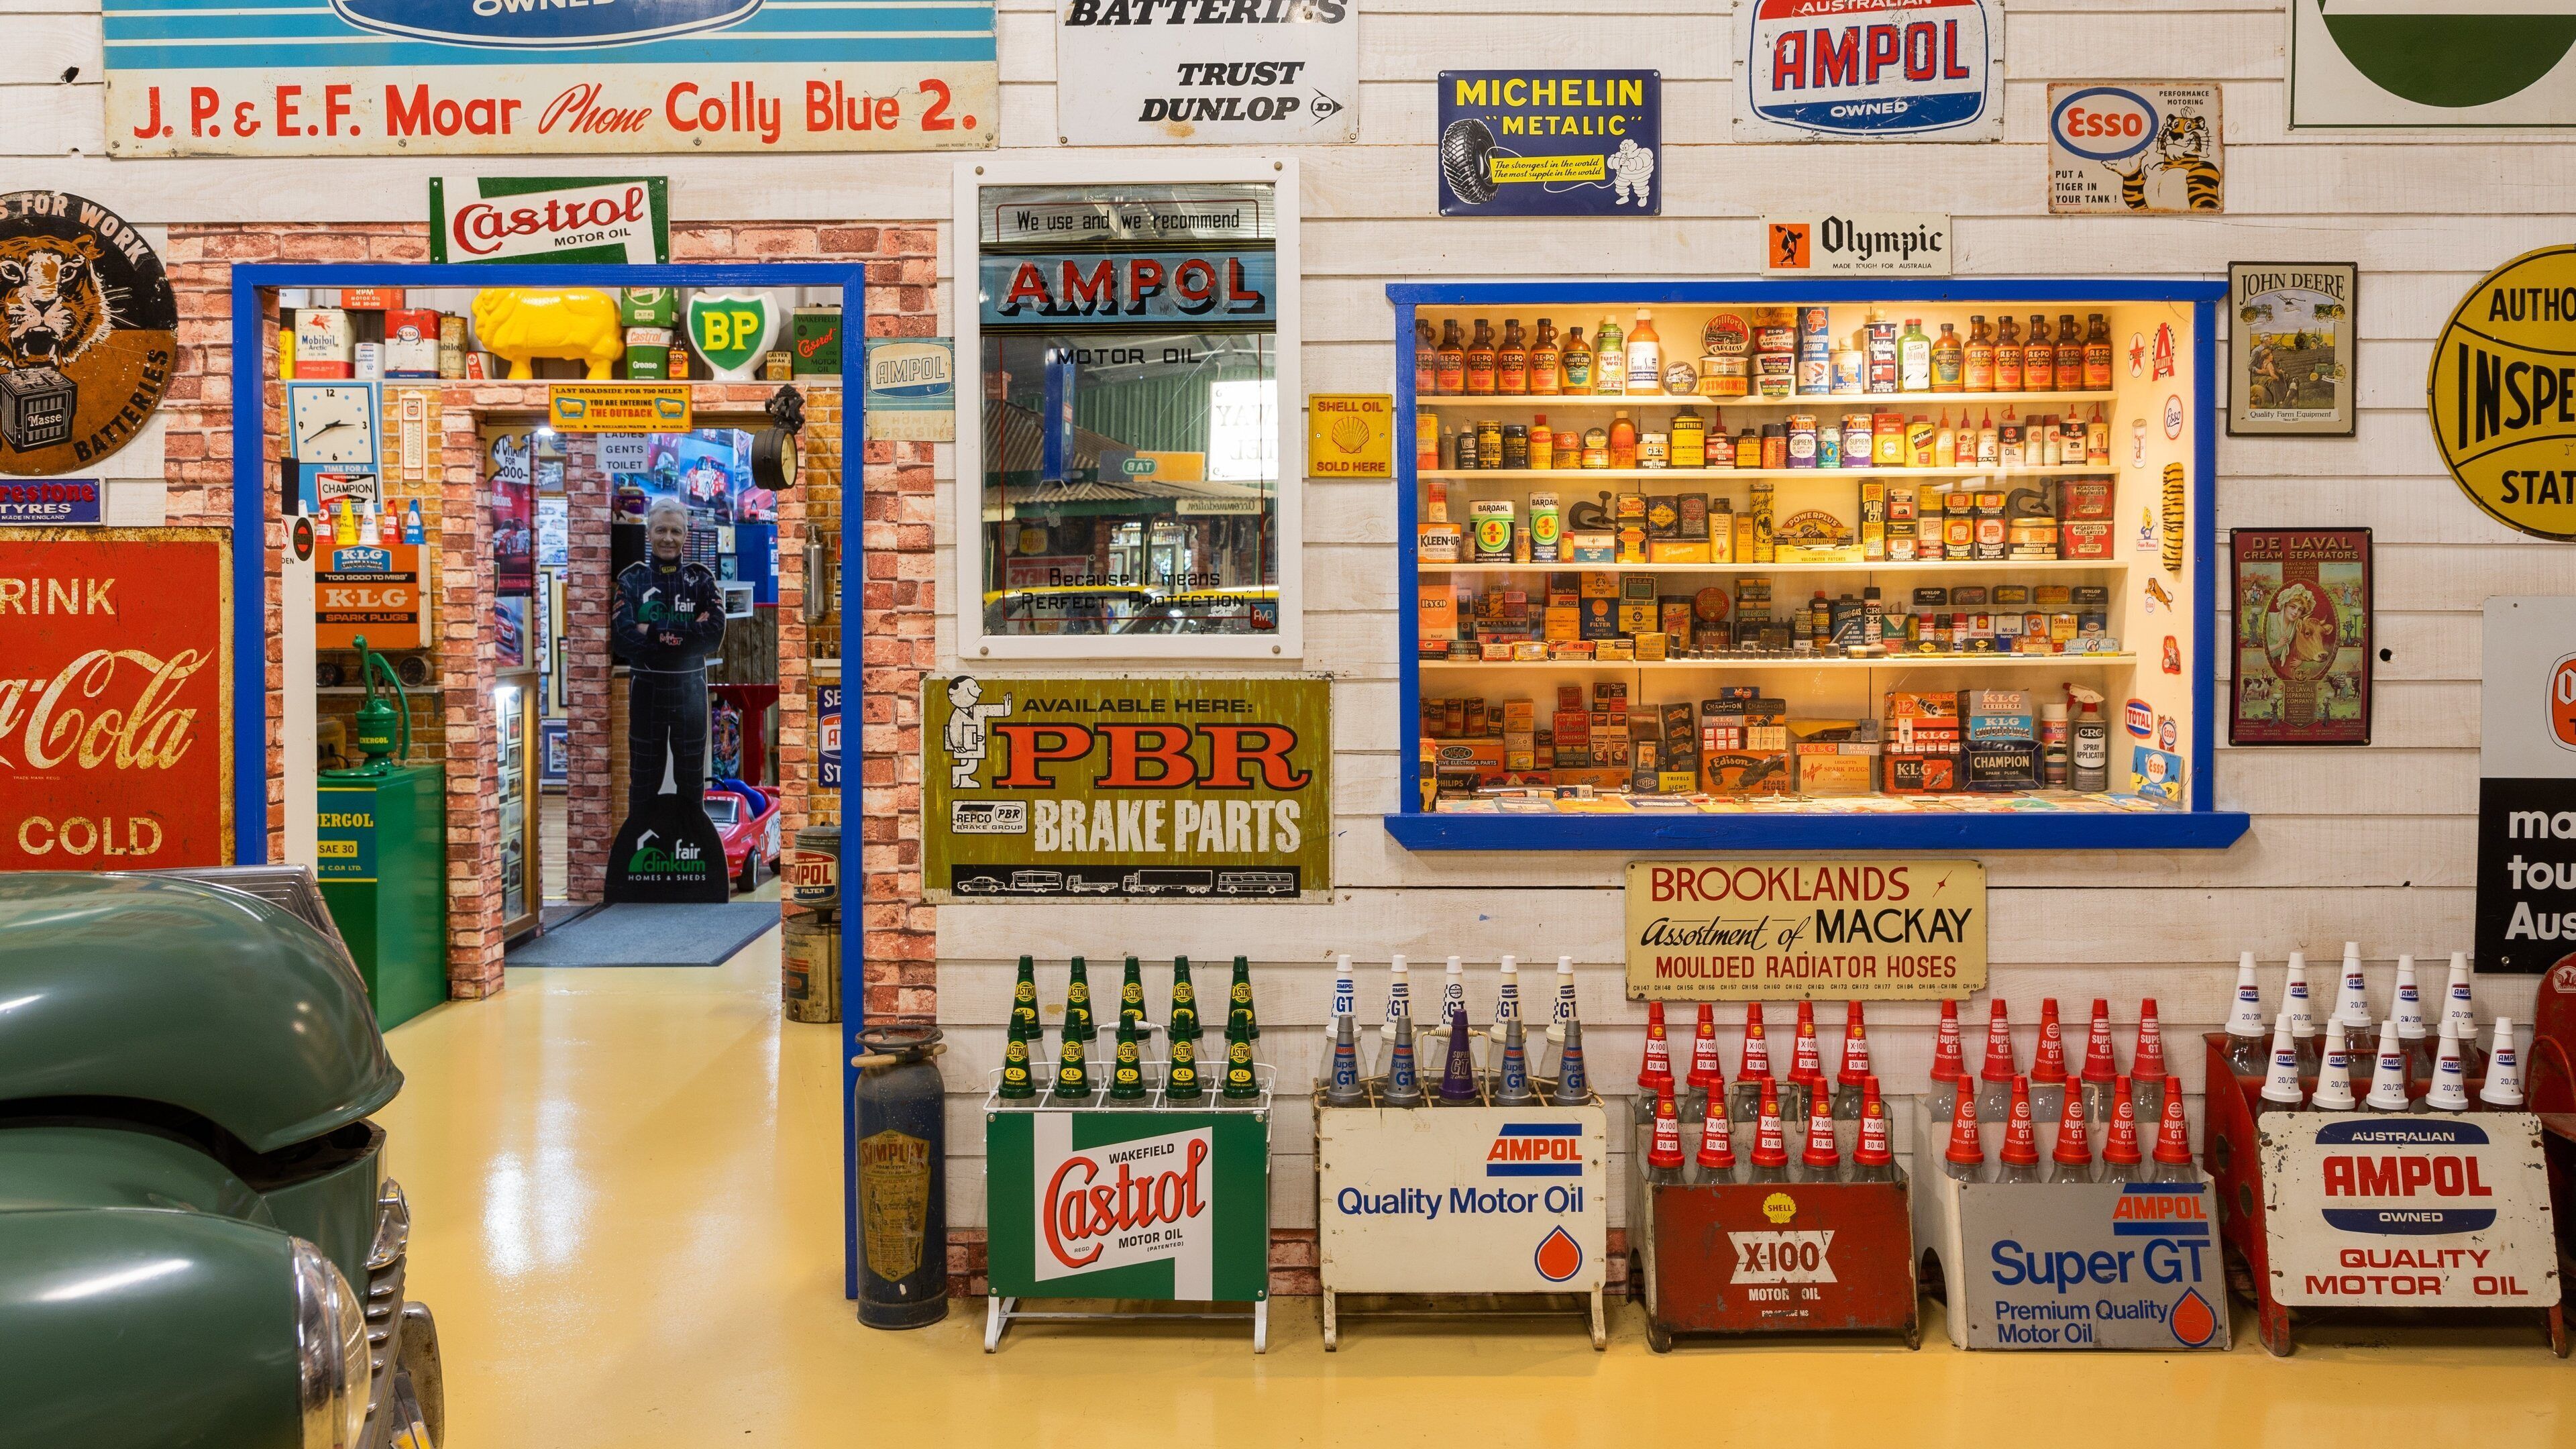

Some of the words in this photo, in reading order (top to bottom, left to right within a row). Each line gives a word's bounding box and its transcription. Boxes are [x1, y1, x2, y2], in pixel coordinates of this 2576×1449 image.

[1772, 19, 1970, 92] AMPOL
[1177, 61, 1305, 86] TRUST
[1456, 77, 1643, 107] MICHELIN
[384, 84, 522, 137] Moar
[538, 83, 653, 134] Phone
[665, 81, 780, 144] Colly
[806, 80, 900, 131] Blue
[919, 78, 977, 131] 2.
[1138, 97, 1299, 123] DUNLOP
[1830, 101, 1909, 117] OWNED
[1494, 170, 1508, 178] The
[1528, 169, 1554, 180] supple
[1578, 167, 1602, 176] world
[1496, 160, 1510, 169] The
[1511, 160, 1548, 172] strongest
[1561, 160, 1574, 168] the
[1574, 158, 1599, 166] world
[2055, 170, 2074, 178] PUT
[2077, 170, 2084, 178] A
[2055, 182, 2083, 191] TIGER
[2087, 182, 2097, 191] IN
[2055, 195, 2081, 203] YOUR
[2085, 195, 2110, 203] TANK
[453, 186, 645, 255] Castrol
[1016, 211, 1040, 231] We
[1047, 215, 1074, 230] use
[1082, 210, 1110, 230] and
[1120, 213, 1142, 229] we
[1152, 208, 1240, 230] recommend
[21, 193, 69, 218] FOR
[78, 201, 150, 268] WORK
[554, 231, 604, 248] MOTOR
[609, 227, 632, 239] OIL
[1821, 215, 1943, 262] Olympic
[998, 257, 1266, 316] AMPOL
[2239, 272, 2287, 306] JOHN
[2290, 272, 2346, 302] DEERE
[797, 315, 838, 323] WAKEFIELD
[630, 331, 664, 343] Castrol
[701, 311, 759, 351] BP
[1057, 348, 1146, 365] MOTOR
[1163, 347, 1201, 364] OIL
[632, 361, 657, 370] Grease
[876, 356, 945, 384] AMPOL
[73, 348, 170, 464] BATTERIES
[590, 409, 608, 417] THE
[609, 409, 653, 418] OUTBACK
[1318, 401, 1359, 412] SHELL
[1361, 401, 1384, 412] OIL
[28, 412, 62, 428] Masse
[2250, 411, 2275, 419] Quality
[2296, 411, 2332, 419] Equipment
[606, 445, 644, 453] GENTS
[606, 461, 643, 470] TOILET
[1316, 462, 1350, 472] SOLD
[1352, 462, 1386, 472] HERE
[322, 484, 373, 494] CHAMPION
[1477, 504, 1509, 514] BARDAHL
[2252, 537, 2282, 551] DE
[2290, 537, 2355, 551] LAVAL
[2243, 551, 2284, 559] CREAM
[2289, 551, 2359, 559] SEPARATORS
[1049, 568, 1130, 587] Because
[1161, 572, 1221, 586] means
[325, 614, 367, 622] SPARK
[370, 613, 409, 621] PLUGS
[1022, 698, 1165, 713] AVAILABLE
[1174, 698, 1253, 713] HERE:
[2127, 709, 2151, 729] TOTAL
[2080, 729, 2104, 738] CRC
[1442, 747, 1473, 759] DISCO
[2076, 751, 2105, 759] APPLICATOR
[2082, 743, 2100, 751] SPRAY
[991, 721, 1313, 792] PBR
[1713, 757, 1753, 767] Edison
[1974, 755, 2030, 769] CHAMPION
[1034, 799, 1166, 853] BRAKE
[1174, 798, 1301, 854] PARTS
[17, 816, 163, 856] COLD
[675, 839, 701, 859] fair
[643, 851, 706, 872] dinkum
[1651, 866, 1910, 902] BROOKLANDS
[1640, 916, 1769, 947] Assortment
[1777, 915, 1809, 953] of
[1815, 908, 1972, 945] MACKAY
[1655, 956, 1755, 979] MOULDED
[1766, 955, 1876, 979] RADIATOR
[1886, 955, 1957, 978] HOSES
[1336, 996, 1354, 1013] GT
[1658, 1140, 1677, 1150] 30/40
[2351, 1132, 2456, 1142] AUSTRALIAN
[1108, 1142, 1175, 1165] WAKEFIELD
[1486, 1138, 1583, 1161] AMPOL
[2322, 1155, 2493, 1197] AMPOL
[1042, 1138, 1208, 1269] Castrol
[1337, 1186, 1443, 1221] Quality
[1450, 1187, 1539, 1214] Motor
[1544, 1185, 1584, 1214] Oil
[1767, 1204, 1792, 1212] SHELL
[2378, 1212, 2444, 1223] OWNED
[1146, 1241, 1185, 1252] (PATENTED)
[1742, 1240, 1820, 1273] X-100
[1990, 1238, 2135, 1294] Super
[2143, 1238, 2211, 1285] GT
